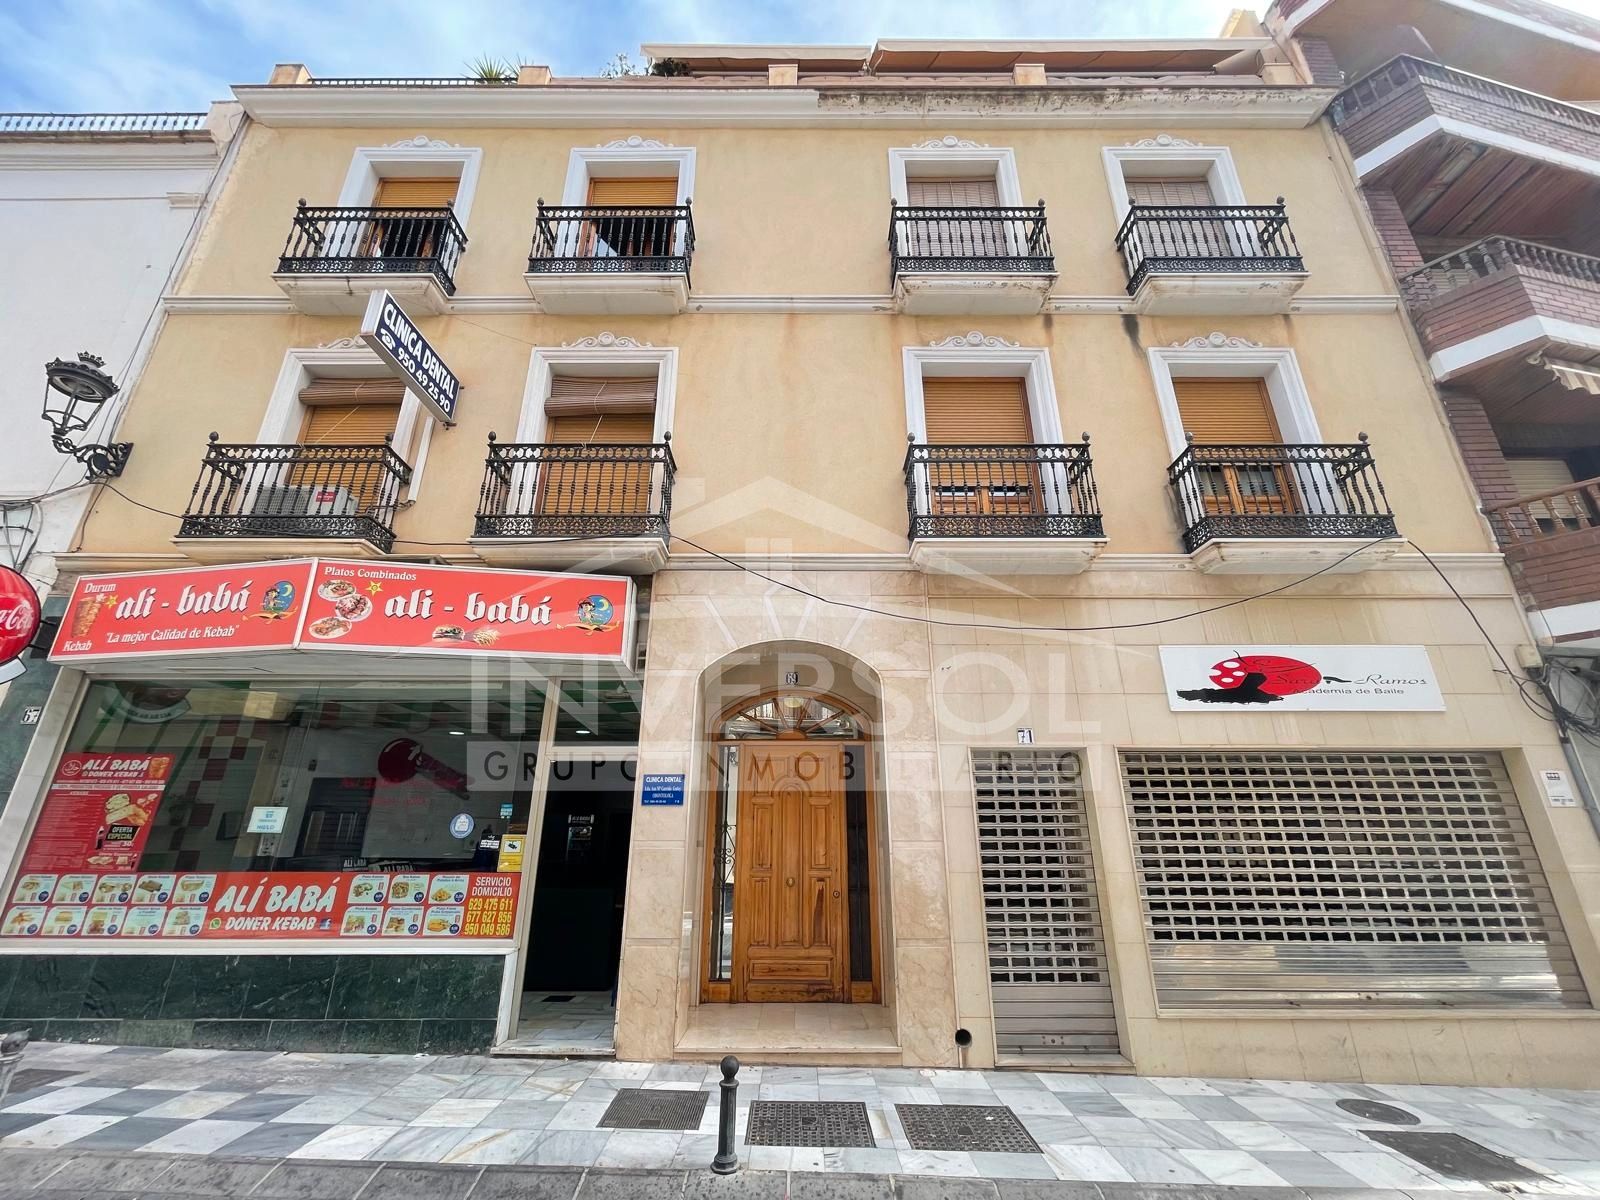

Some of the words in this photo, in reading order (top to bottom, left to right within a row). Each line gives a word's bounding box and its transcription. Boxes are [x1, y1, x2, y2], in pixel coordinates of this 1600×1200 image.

[384, 303, 422, 362] CLINICA
[422, 348, 454, 399] DENTAL
[398, 347, 415, 374] 950
[416, 369, 428, 386] 49
[428, 382, 439, 400] 25
[439, 395, 450, 413] 90
[324, 566, 354, 578] Platos
[357, 568, 417, 581] Combinados
[84, 582, 117, 594] Durum
[115, 587, 155, 620] ali
[176, 580, 254, 617] babá
[384, 588, 434, 620] ali
[464, 592, 552, 625] babá
[121, 631, 149, 644] mejor
[151, 628, 187, 641] Calidad
[189, 629, 201, 639] de
[63, 640, 92, 652] Kebab
[785, 672, 799, 685] 69
[1354, 673, 1428, 685] Ramos
[23, 708, 40, 723] 67
[1018, 729, 1033, 743] 71
[82, 756, 111, 770] ALÍ
[110, 756, 152, 771] BABÁ
[475, 877, 512, 886] SERVICIO
[214, 877, 268, 912] ALÍ
[265, 877, 340, 912] BABÁ
[471, 886, 513, 897] DOMICILIO
[468, 898, 482, 910] 629
[483, 898, 498, 910] 475
[499, 898, 513, 910] 611
[466, 911, 481, 922] 677
[482, 911, 497, 922] 627
[225, 917, 271, 931] DONER
[271, 917, 317, 931] KEBAB
[464, 923, 479, 935] 950
[480, 923, 495, 935] 049
[495, 924, 511, 936] 586
